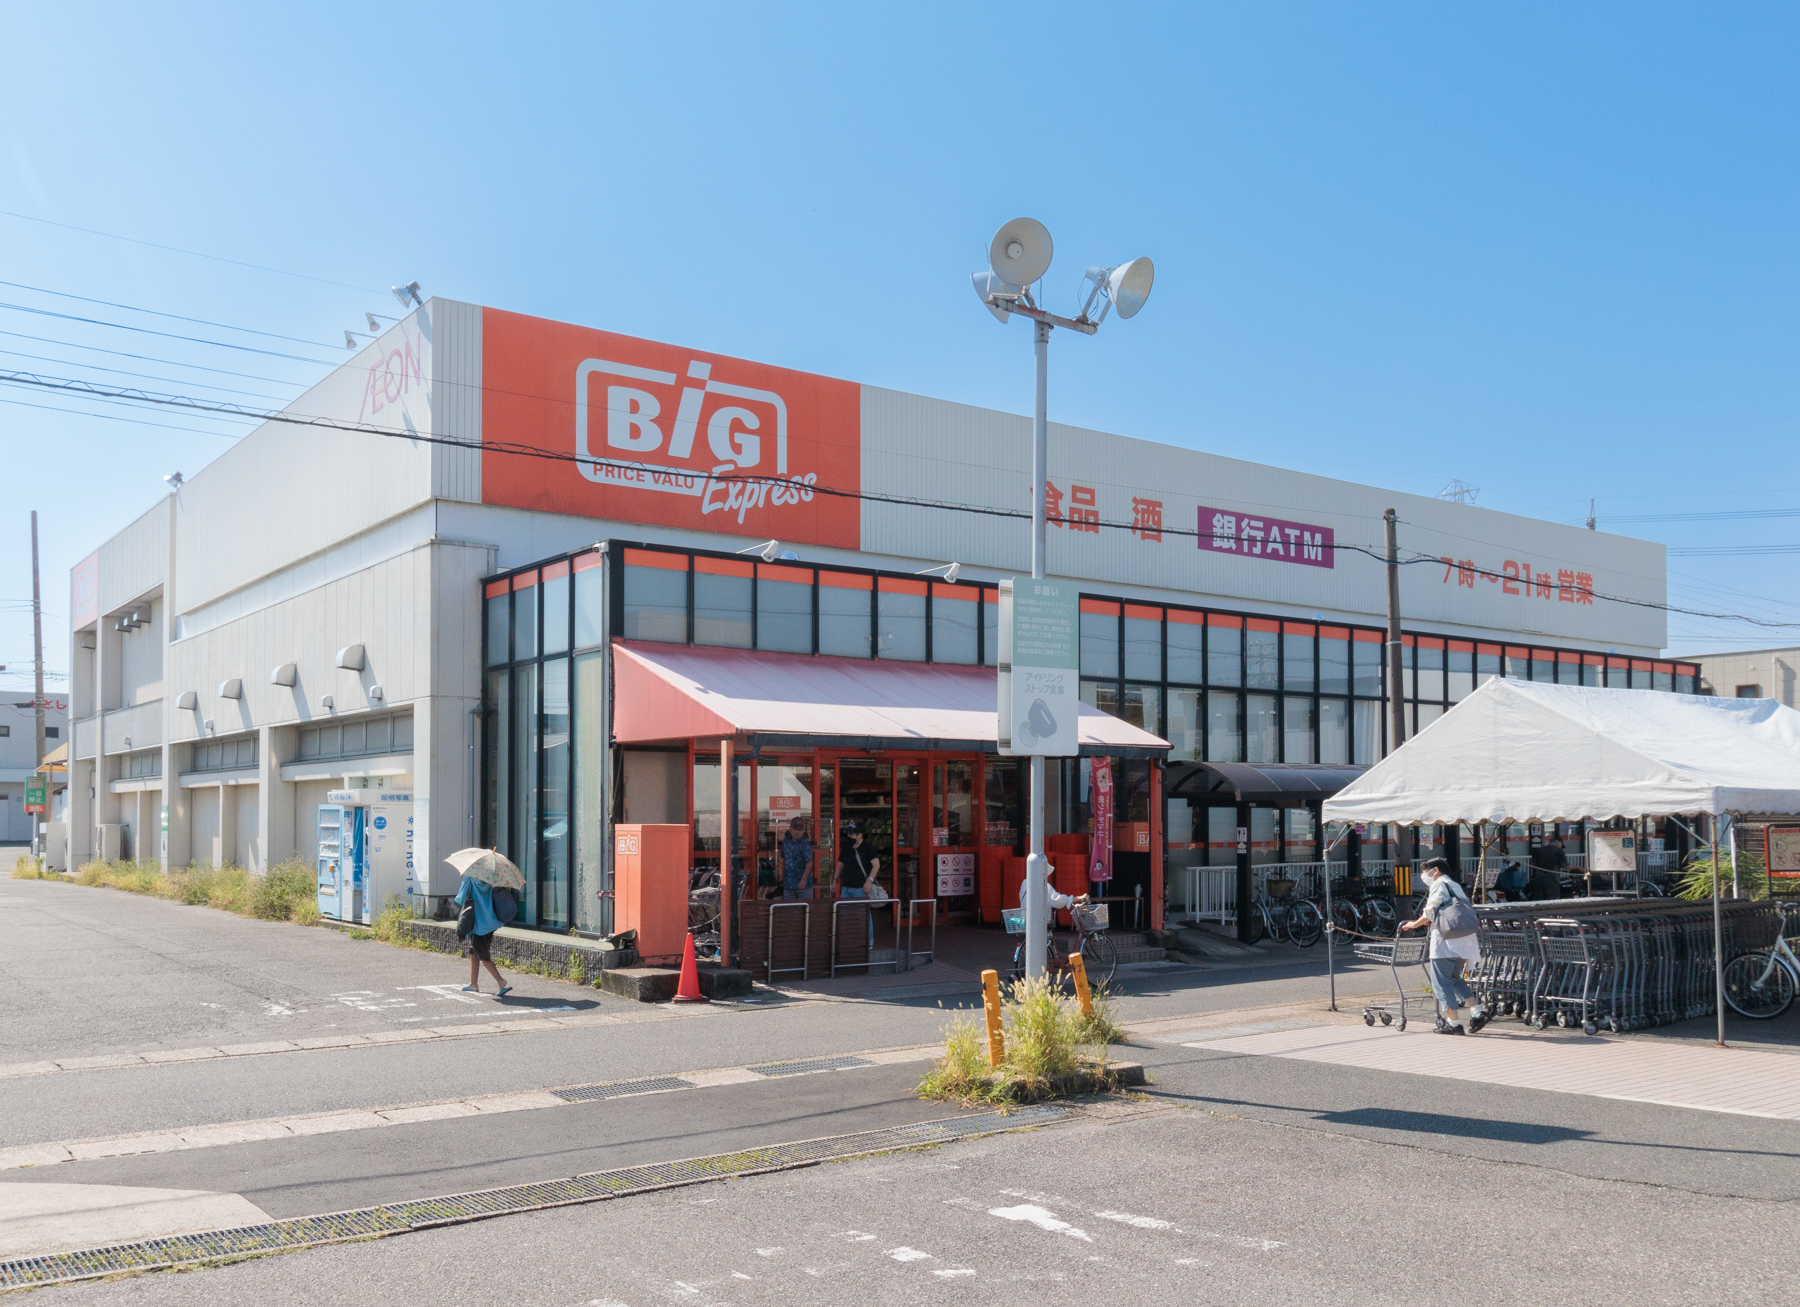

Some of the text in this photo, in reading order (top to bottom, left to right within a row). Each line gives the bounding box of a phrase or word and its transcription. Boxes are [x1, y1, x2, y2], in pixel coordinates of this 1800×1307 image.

[593, 463, 695, 489] PRICE VALU
[702, 463, 817, 525] Express
[1030, 481, 1162, 543] 食品 酒
[1212, 513, 1323, 561] 銀行ATM
[1034, 585, 1059, 596] お願い
[1025, 672, 1064, 683] アイドリング
